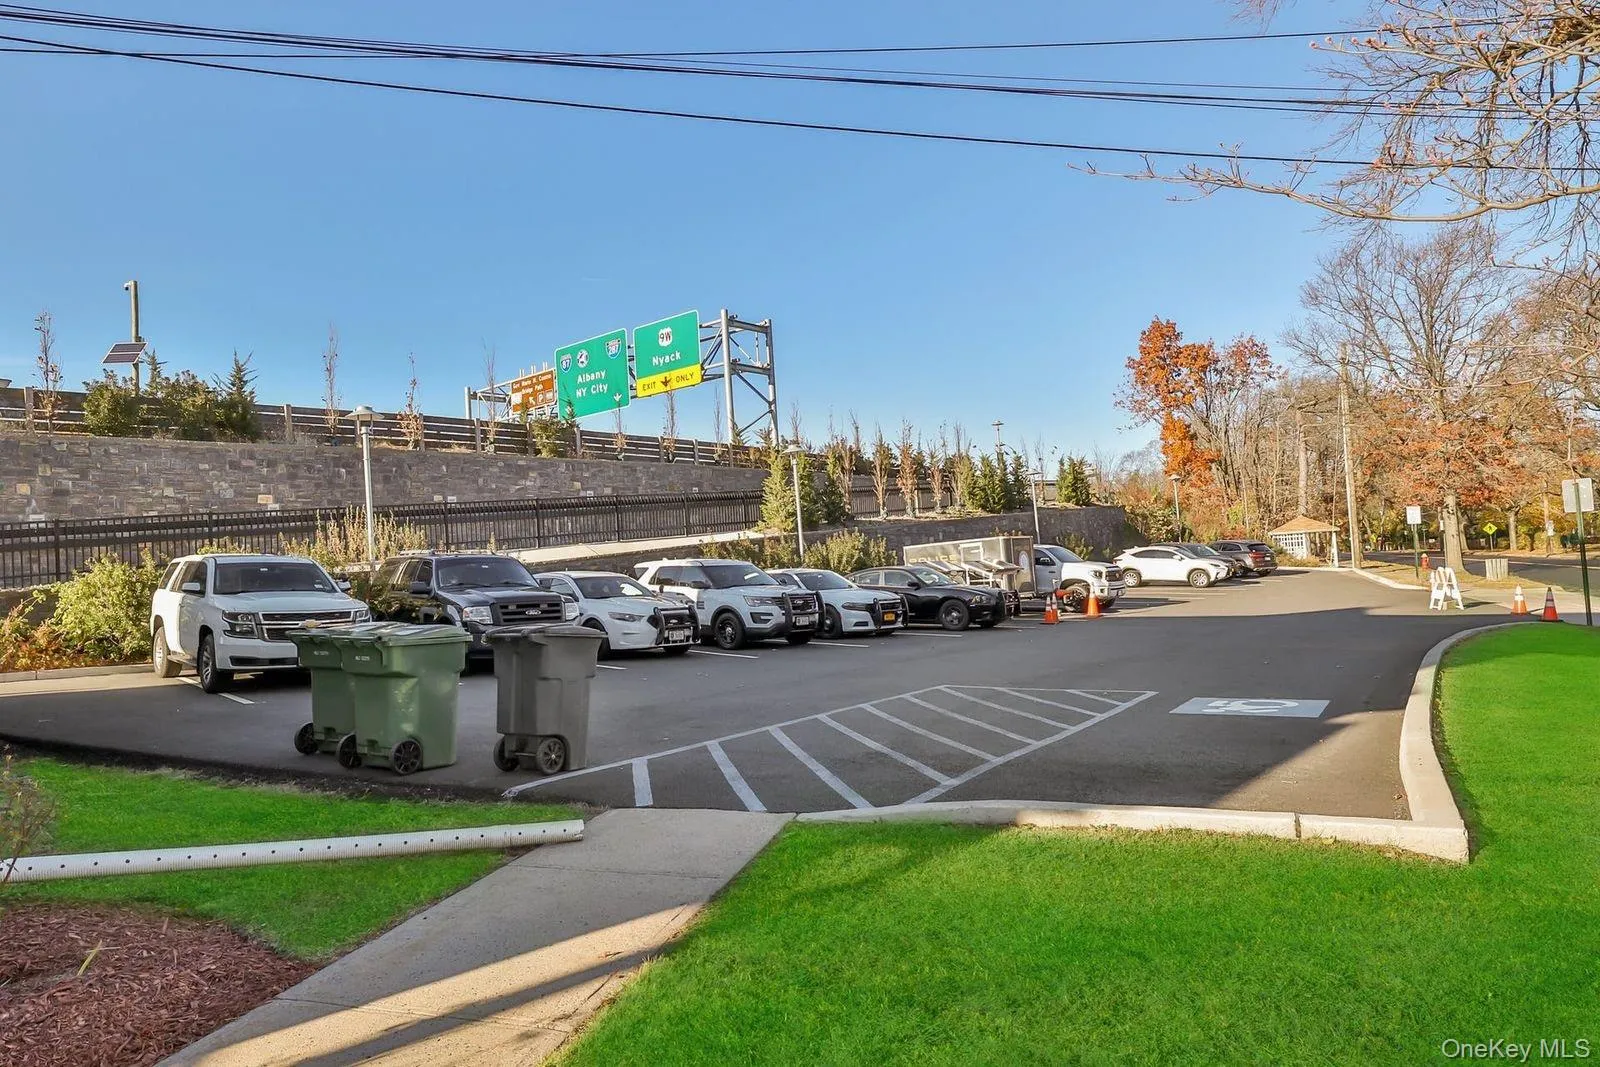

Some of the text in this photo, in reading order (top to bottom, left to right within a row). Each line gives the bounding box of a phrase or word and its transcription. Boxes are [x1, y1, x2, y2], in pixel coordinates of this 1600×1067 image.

[659, 330, 672, 343] 9W
[561, 359, 571, 369] 87
[652, 350, 681, 367] Nyack
[577, 369, 606, 385] Albany
[642, 372, 694, 391] EXIT ONLY
[575, 383, 608, 398] NY City
